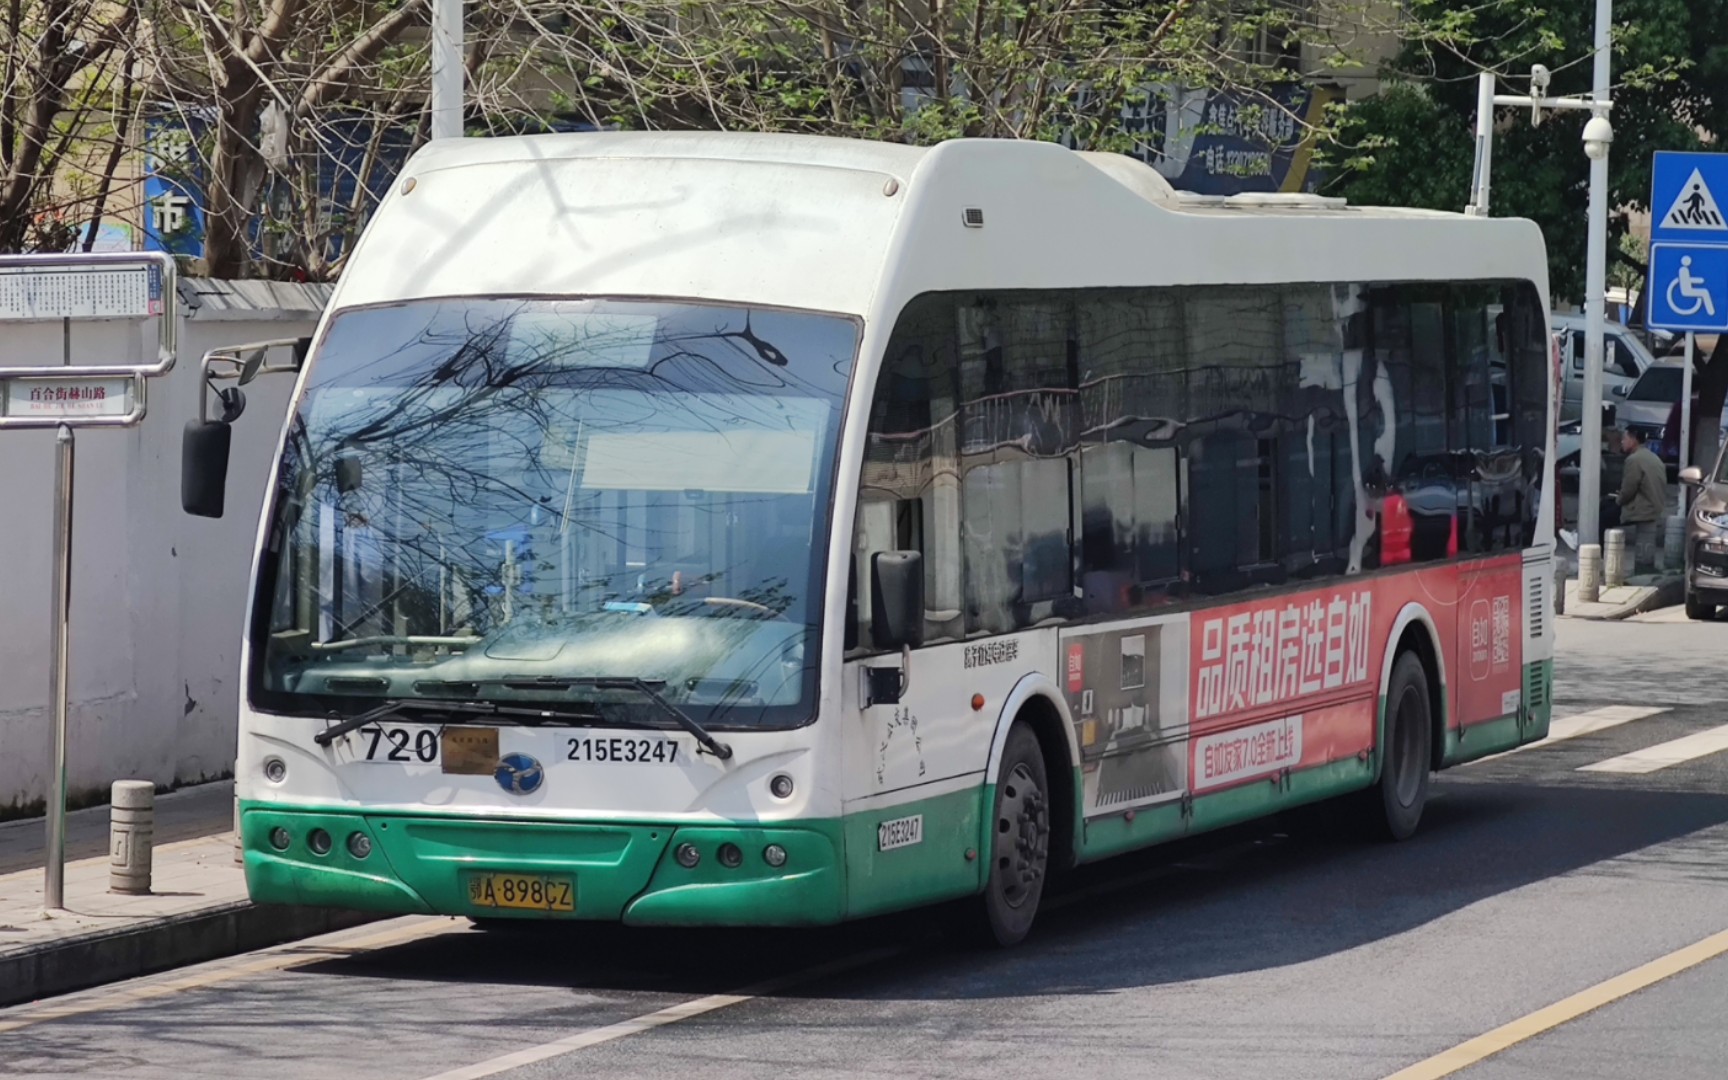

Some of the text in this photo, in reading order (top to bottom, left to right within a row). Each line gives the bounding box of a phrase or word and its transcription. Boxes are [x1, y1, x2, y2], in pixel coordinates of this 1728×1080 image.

[29, 386, 105, 401] 百合街赫山路
[1196, 590, 1371, 719] 品质租房选自如
[361, 727, 438, 763] 720
[567, 738, 679, 763] 215E3247
[881, 817, 919, 848] 215E3247
